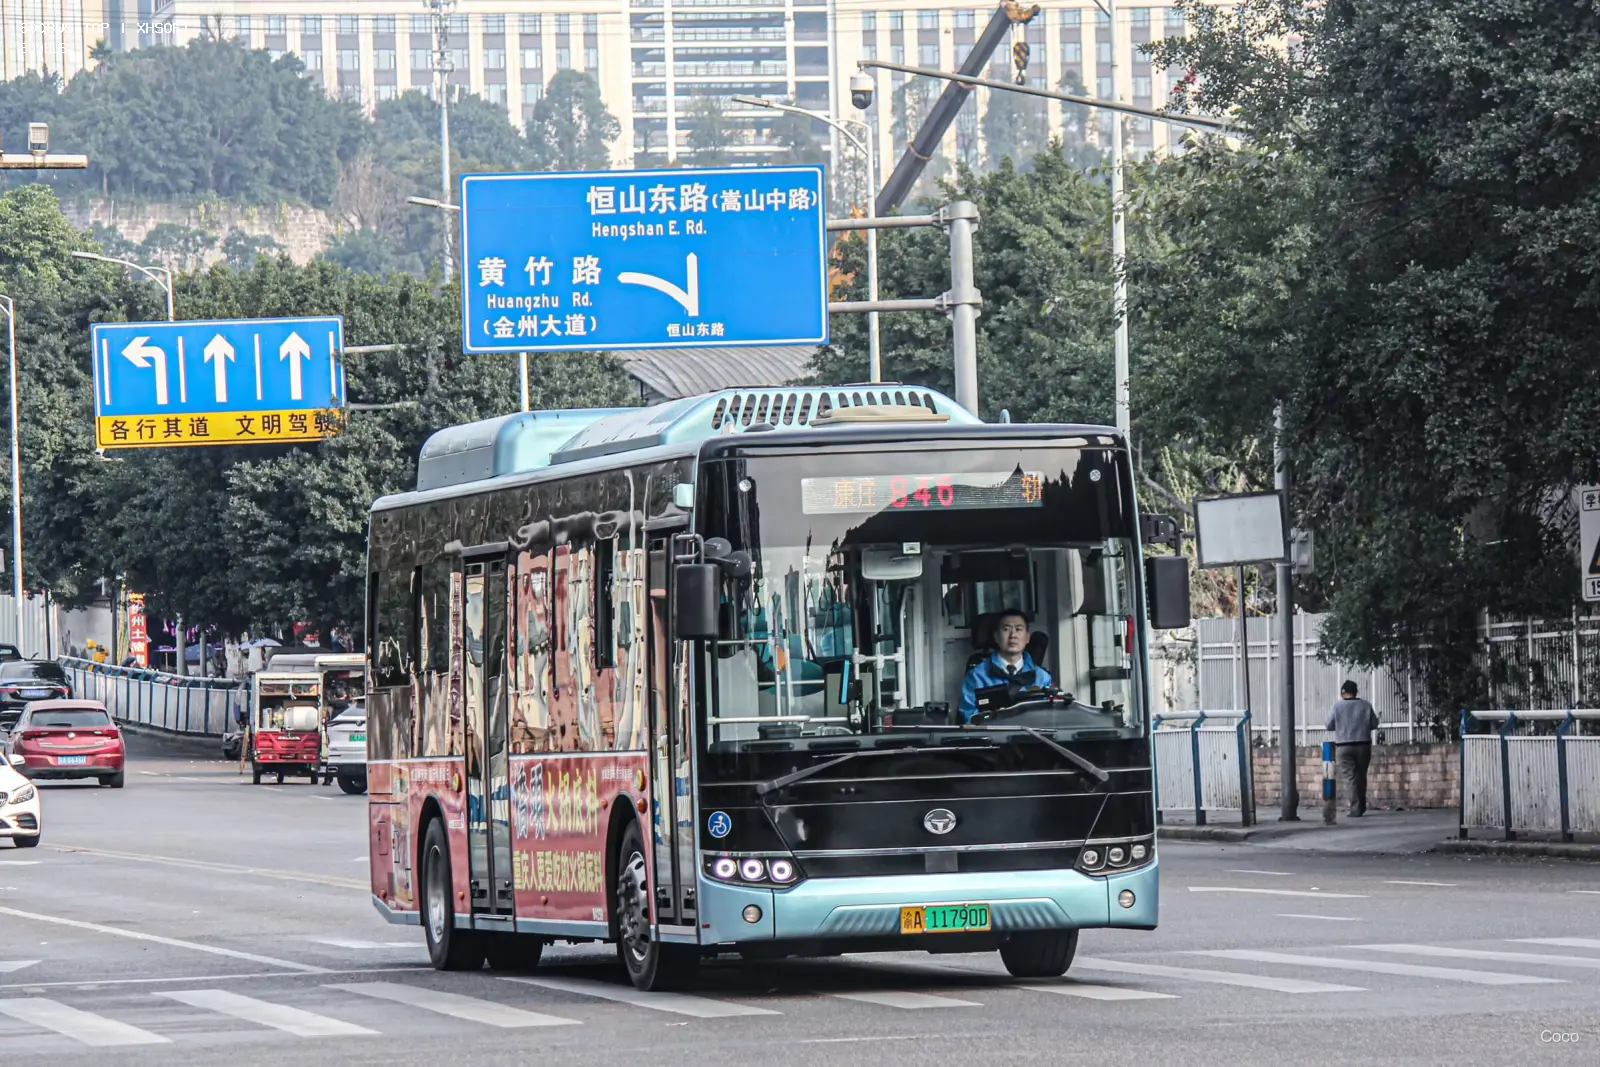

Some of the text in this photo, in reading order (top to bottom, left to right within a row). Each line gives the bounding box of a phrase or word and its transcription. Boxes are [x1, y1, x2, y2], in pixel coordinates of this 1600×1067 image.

[592, 220, 707, 241] Hengshan E. Rd.
[487, 292, 593, 312] Huangzhu Rd.
[667, 323, 725, 338] 恒山东路
[110, 416, 210, 441] 各行其道
[889, 475, 955, 509] 846
